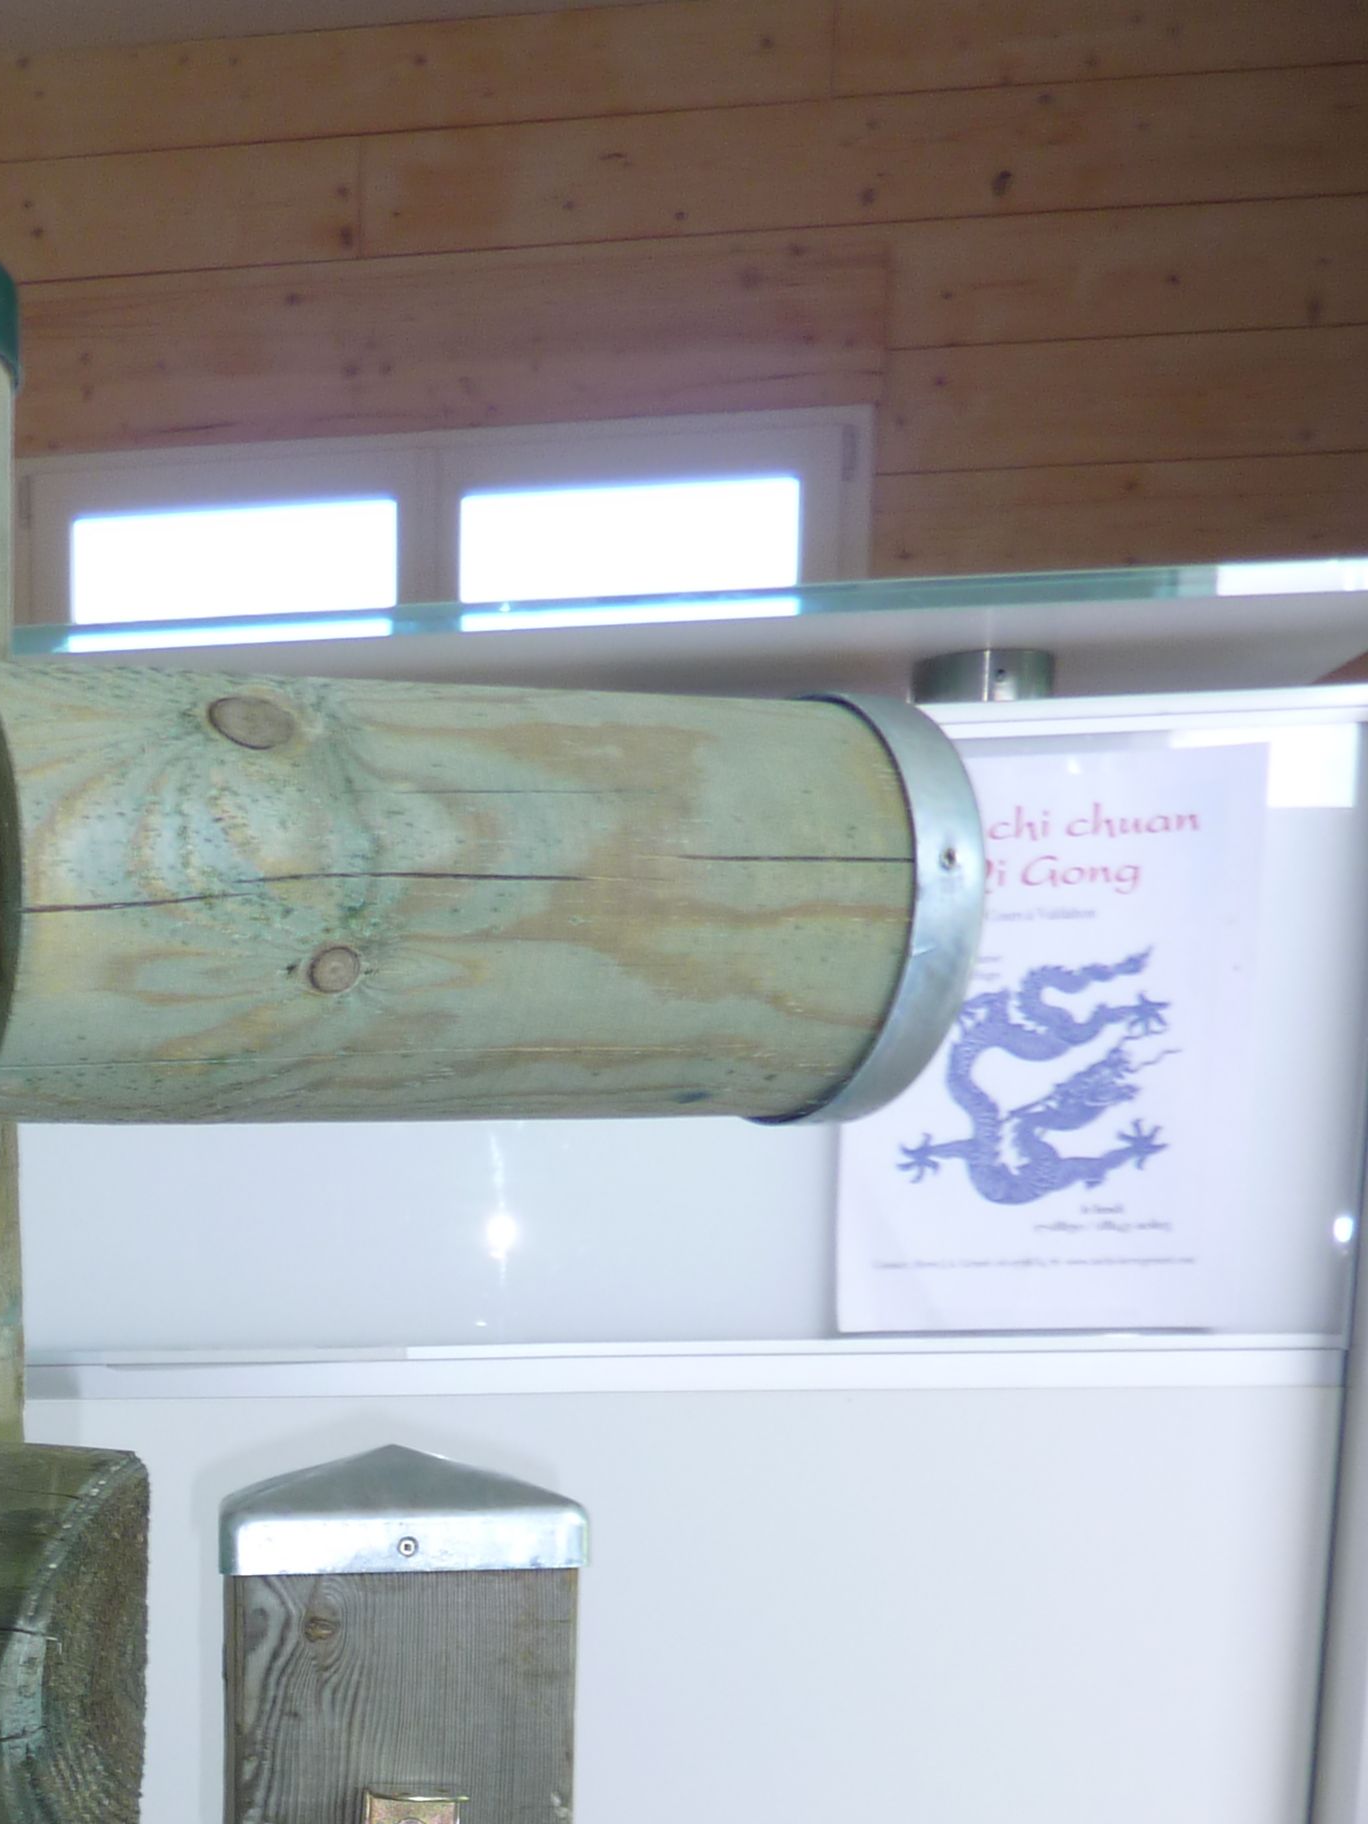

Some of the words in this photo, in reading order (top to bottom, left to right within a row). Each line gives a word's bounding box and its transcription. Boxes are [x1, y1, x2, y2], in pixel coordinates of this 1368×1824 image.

[988, 805, 1050, 841] chi
[1065, 801, 1200, 838] chuan
[1020, 854, 1140, 895] Gong
